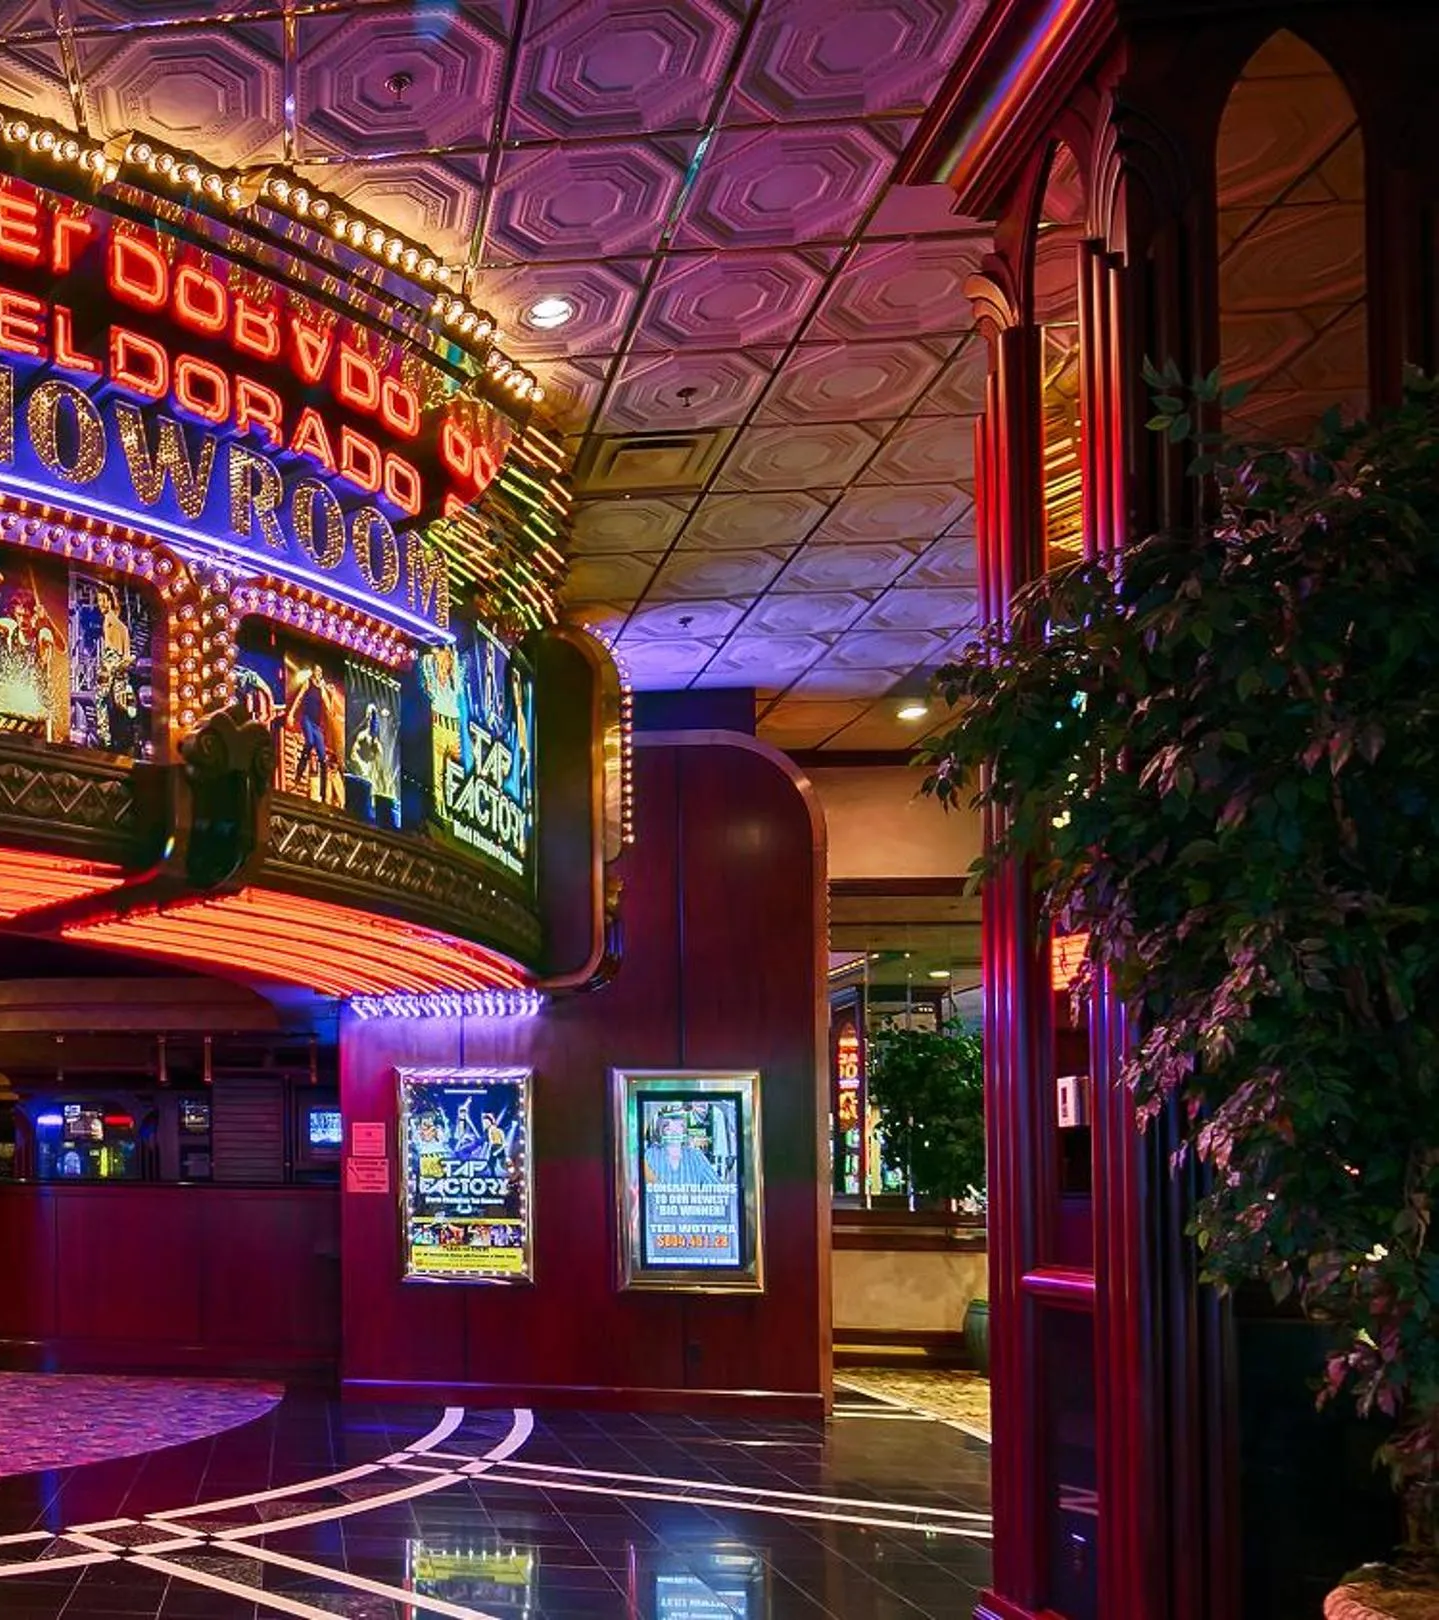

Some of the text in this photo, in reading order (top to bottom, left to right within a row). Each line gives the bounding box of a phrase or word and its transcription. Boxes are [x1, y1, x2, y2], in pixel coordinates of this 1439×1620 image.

[470, 721, 512, 790] TAP
[446, 758, 526, 855] FACTORY
[419, 1177, 510, 1196] FACTORY
[440, 1160, 488, 1178] TAP
